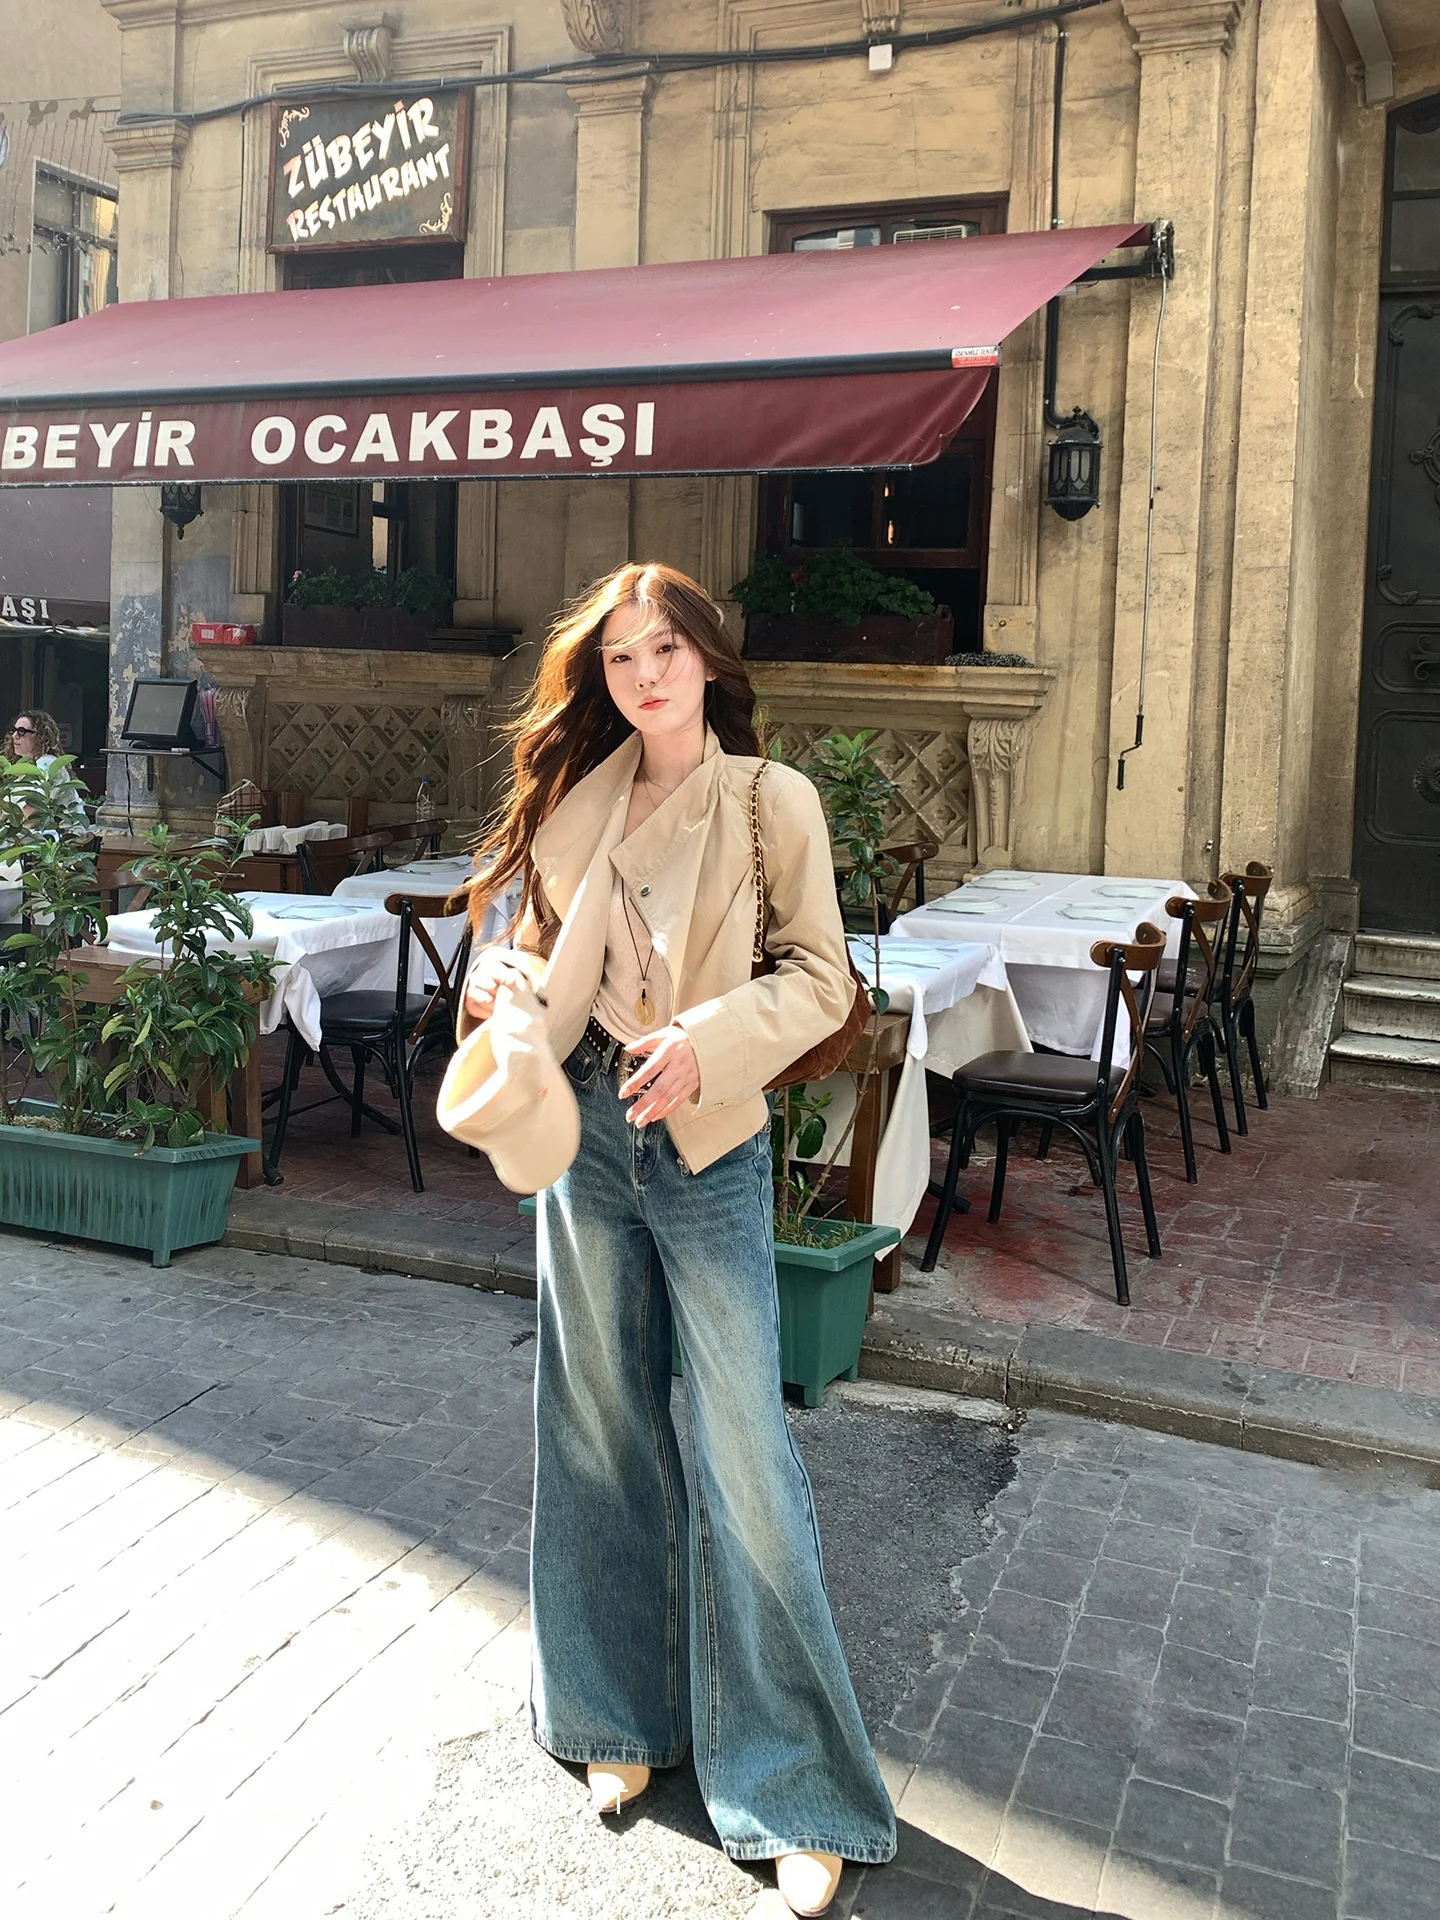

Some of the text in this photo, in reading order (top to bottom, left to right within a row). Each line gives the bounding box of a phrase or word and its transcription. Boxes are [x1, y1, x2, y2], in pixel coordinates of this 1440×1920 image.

[283, 97, 440, 199] ZÜBEYİR
[286, 143, 450, 242] RESTAURANT
[1, 402, 655, 469] BEYİR OCAKBAŞI
[1, 595, 49, 624] AŞI
